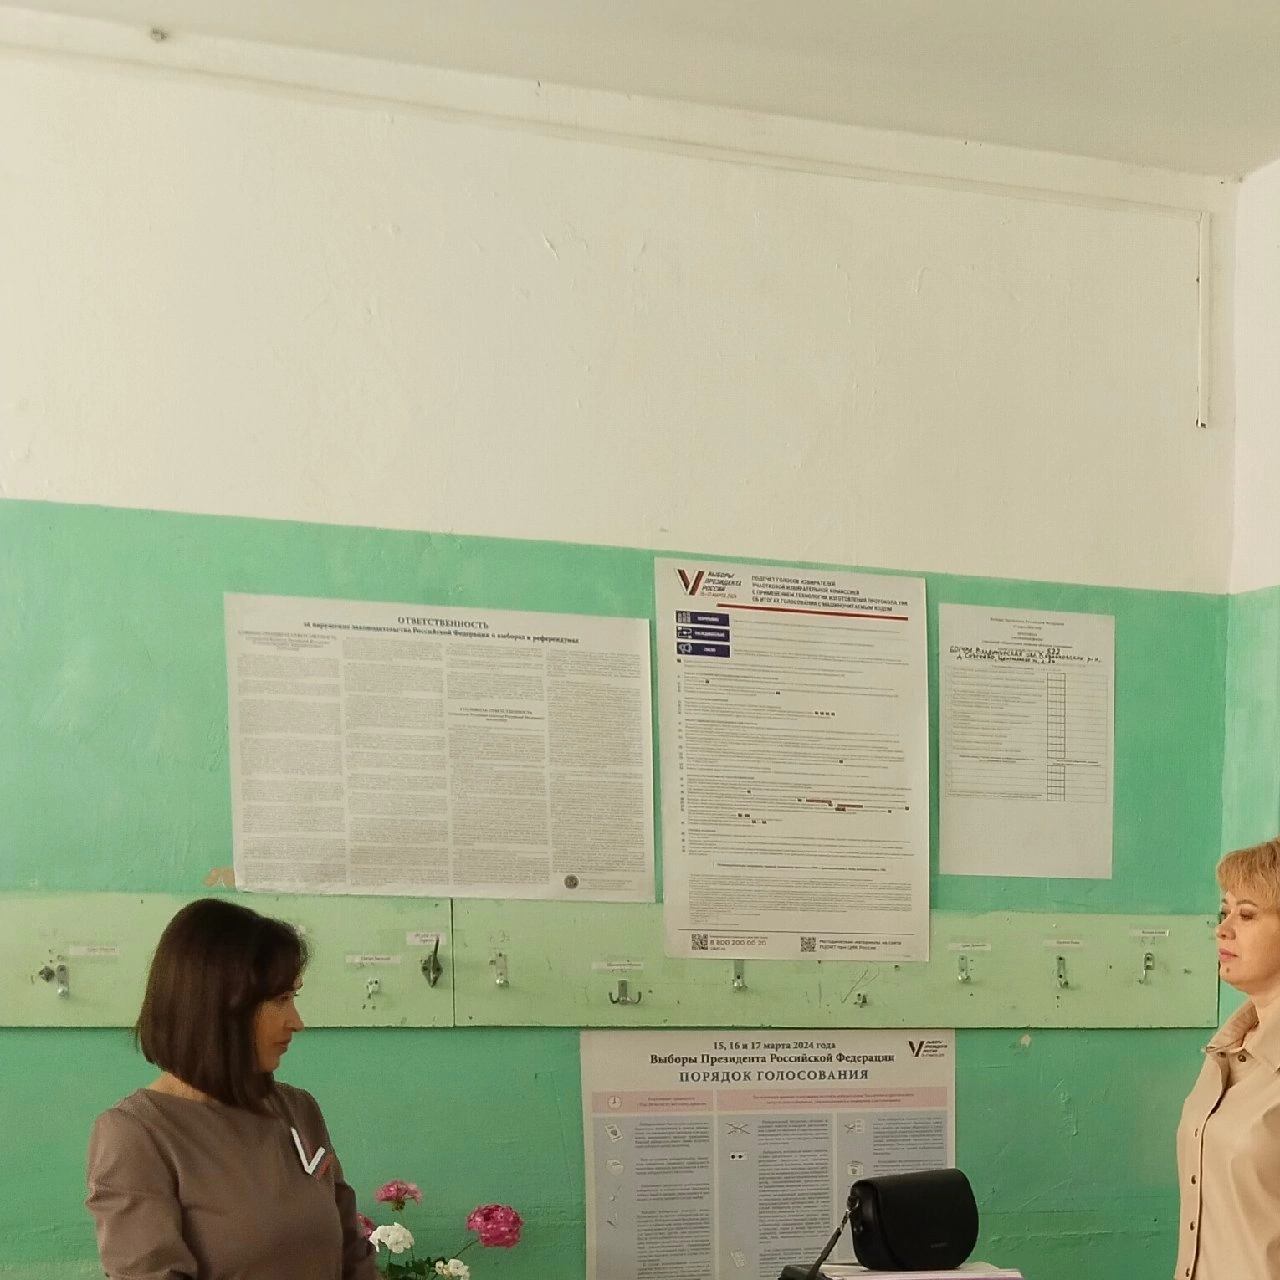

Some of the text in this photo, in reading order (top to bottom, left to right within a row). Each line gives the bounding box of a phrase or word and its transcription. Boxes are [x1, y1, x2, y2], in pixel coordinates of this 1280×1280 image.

[397, 616, 489, 629] ОТВЕТСТВЕННОСТЬ
[713, 1042, 727, 1051] 15,
[730, 1042, 740, 1050] 16
[763, 1043, 791, 1051] марта
[792, 1041, 814, 1049] 2024
[816, 1043, 836, 1051] года
[650, 1051, 896, 1067] Выборы Президента Российской Федерации
[679, 1069, 870, 1083] ПОРЯДОК ГОЛОСОВАНИЯ
